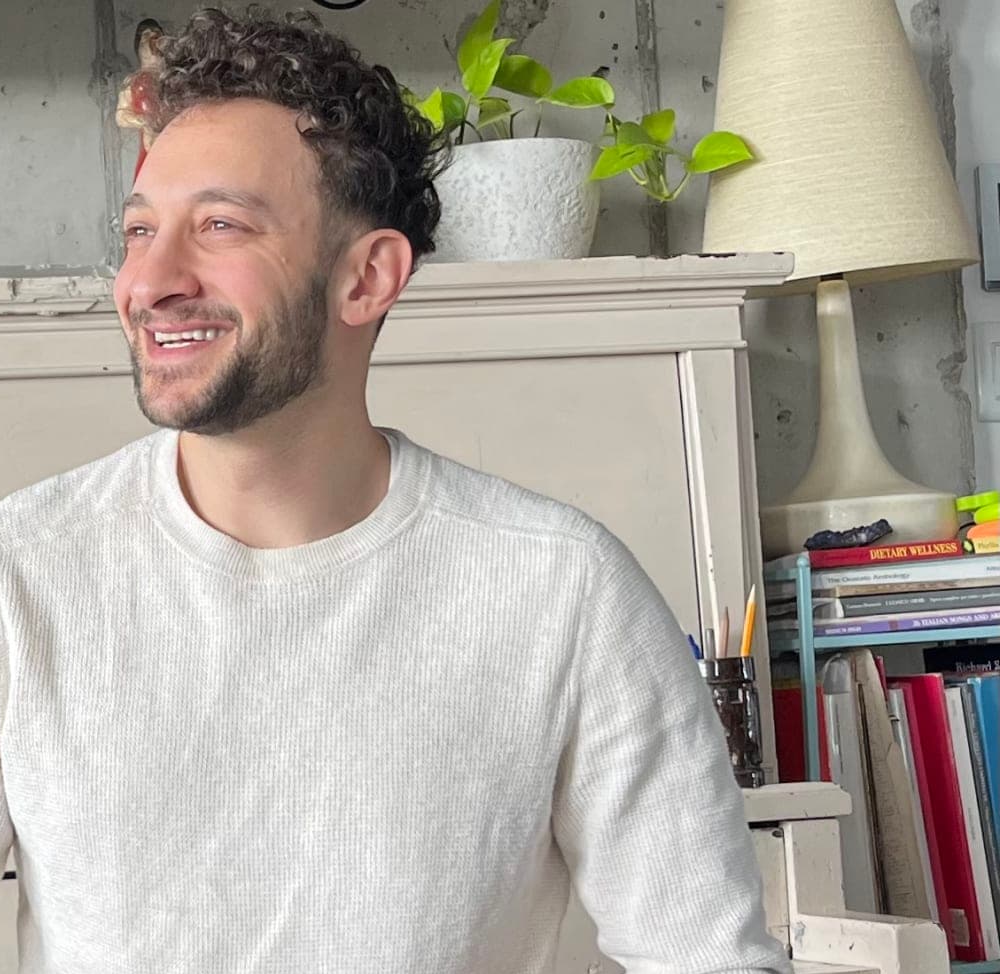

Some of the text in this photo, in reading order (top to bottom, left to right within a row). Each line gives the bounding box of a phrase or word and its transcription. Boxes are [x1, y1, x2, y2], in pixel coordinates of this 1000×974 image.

[870, 542, 957, 560] DIETARY WELLNESS
[921, 617, 949, 625] ITALIAN
[949, 615, 973, 623] SONGS
[973, 614, 990, 622] AND
